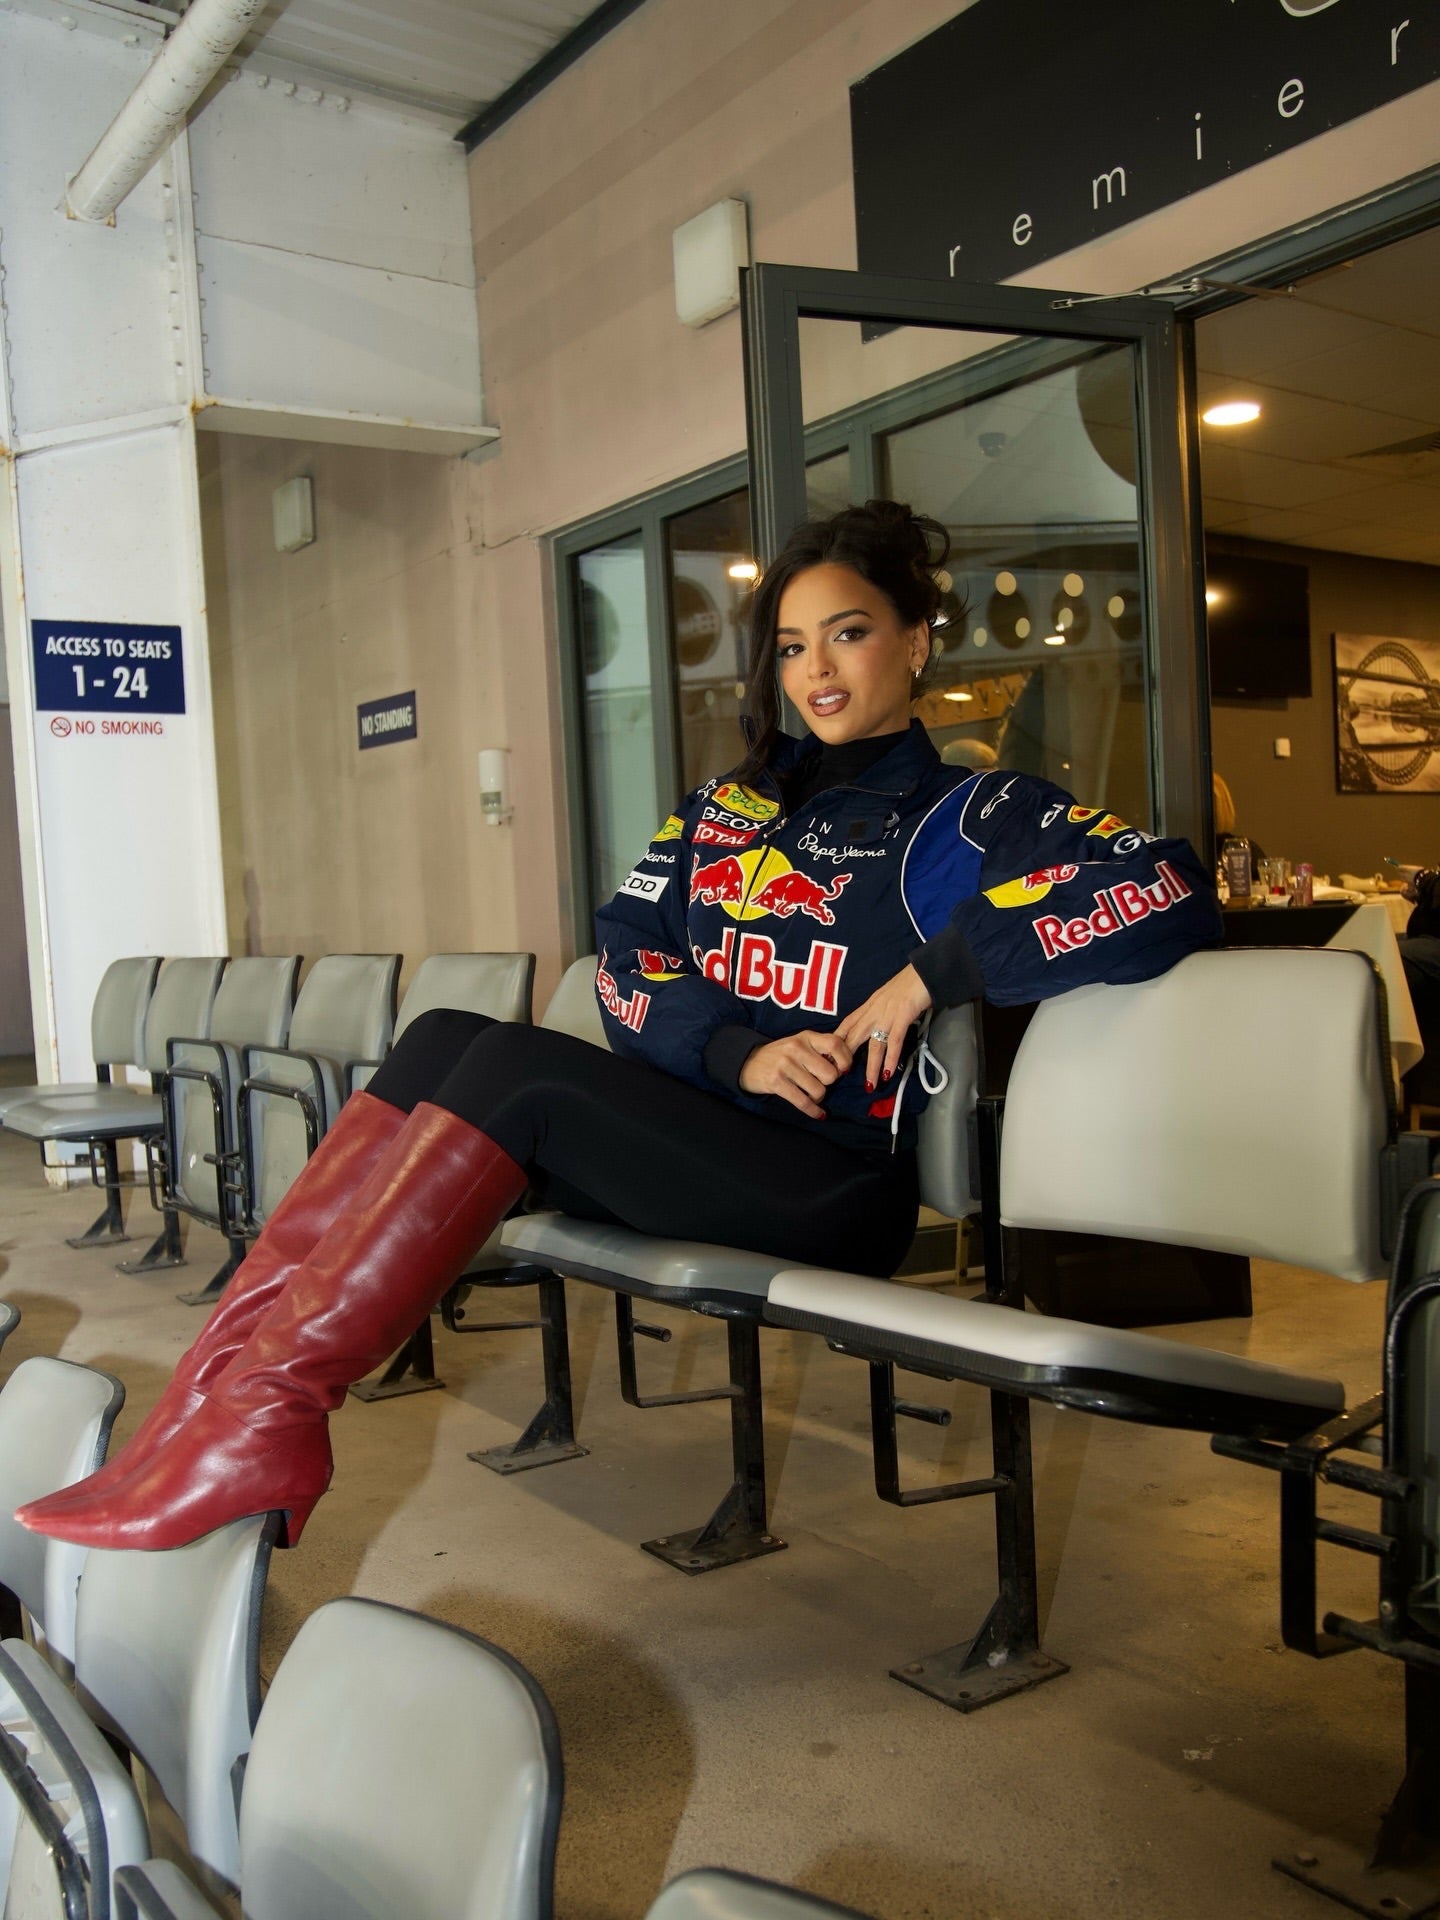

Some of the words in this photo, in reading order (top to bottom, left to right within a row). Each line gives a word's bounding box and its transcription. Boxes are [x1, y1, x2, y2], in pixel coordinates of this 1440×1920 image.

[46, 636, 101, 656] ACCESS
[104, 638, 125, 657] TO
[128, 640, 172, 659] SEATS
[72, 665, 85, 697] 1
[112, 666, 149, 698] 24
[75, 720, 95, 734] NO
[101, 720, 163, 735] SMOKING
[361, 715, 373, 736] NO
[374, 705, 413, 734] STANDING
[694, 823, 746, 845] TOTAL
[702, 806, 769, 831] GEOX
[797, 832, 837, 861] Pepe
[832, 845, 887, 865] Jeans
[1032, 889, 1124, 960] Red
[1109, 860, 1192, 926] Bull
[734, 932, 849, 1016] Bull
